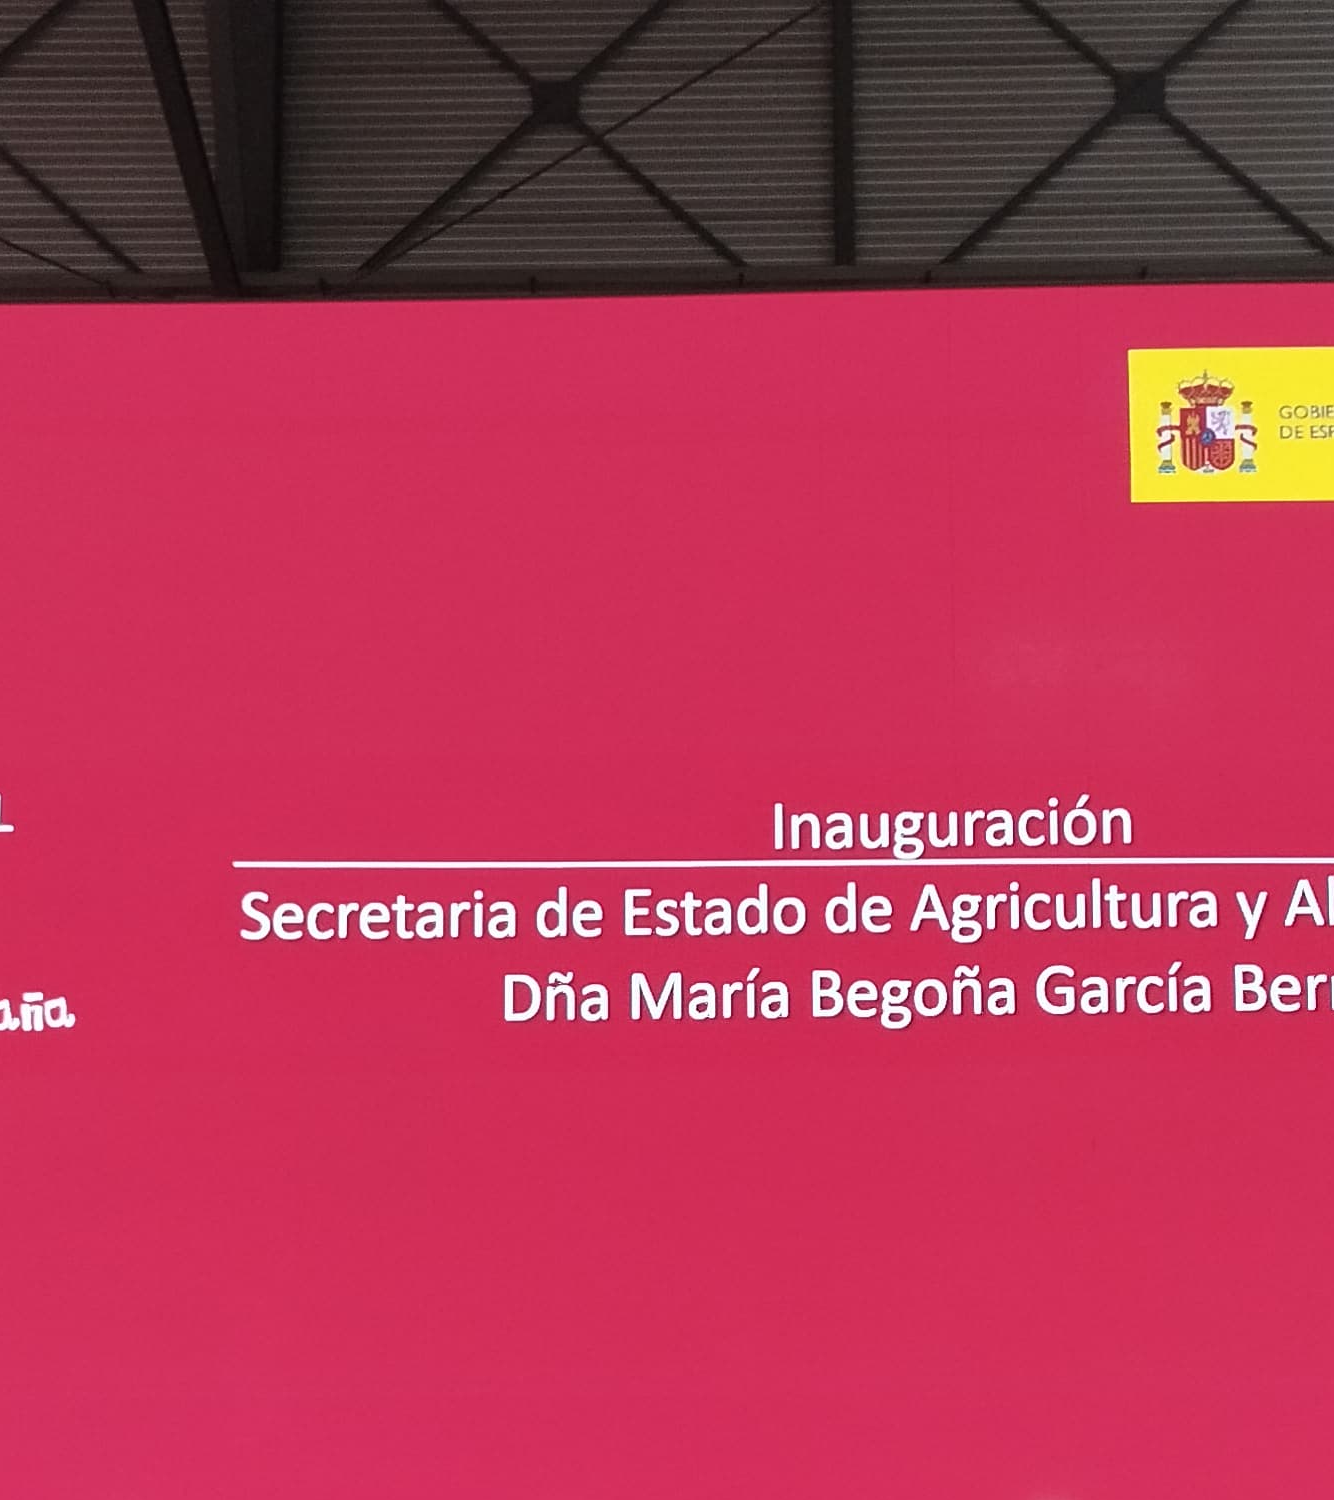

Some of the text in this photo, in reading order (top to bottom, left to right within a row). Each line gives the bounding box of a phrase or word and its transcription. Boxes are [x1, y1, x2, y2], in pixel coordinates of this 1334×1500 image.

[1279, 424, 1304, 439] DE
[773, 793, 1133, 859] Inauguración
[239, 889, 518, 941] Secretaria
[536, 886, 603, 938] de
[624, 883, 807, 937] Estado
[824, 881, 893, 934] de
[909, 877, 1219, 944] Agricultura
[1235, 891, 1268, 940] y
[503, 971, 610, 1023] Dña
[630, 967, 790, 1020] María
[811, 964, 1017, 1030] Begoña
[1035, 961, 1212, 1016] García
